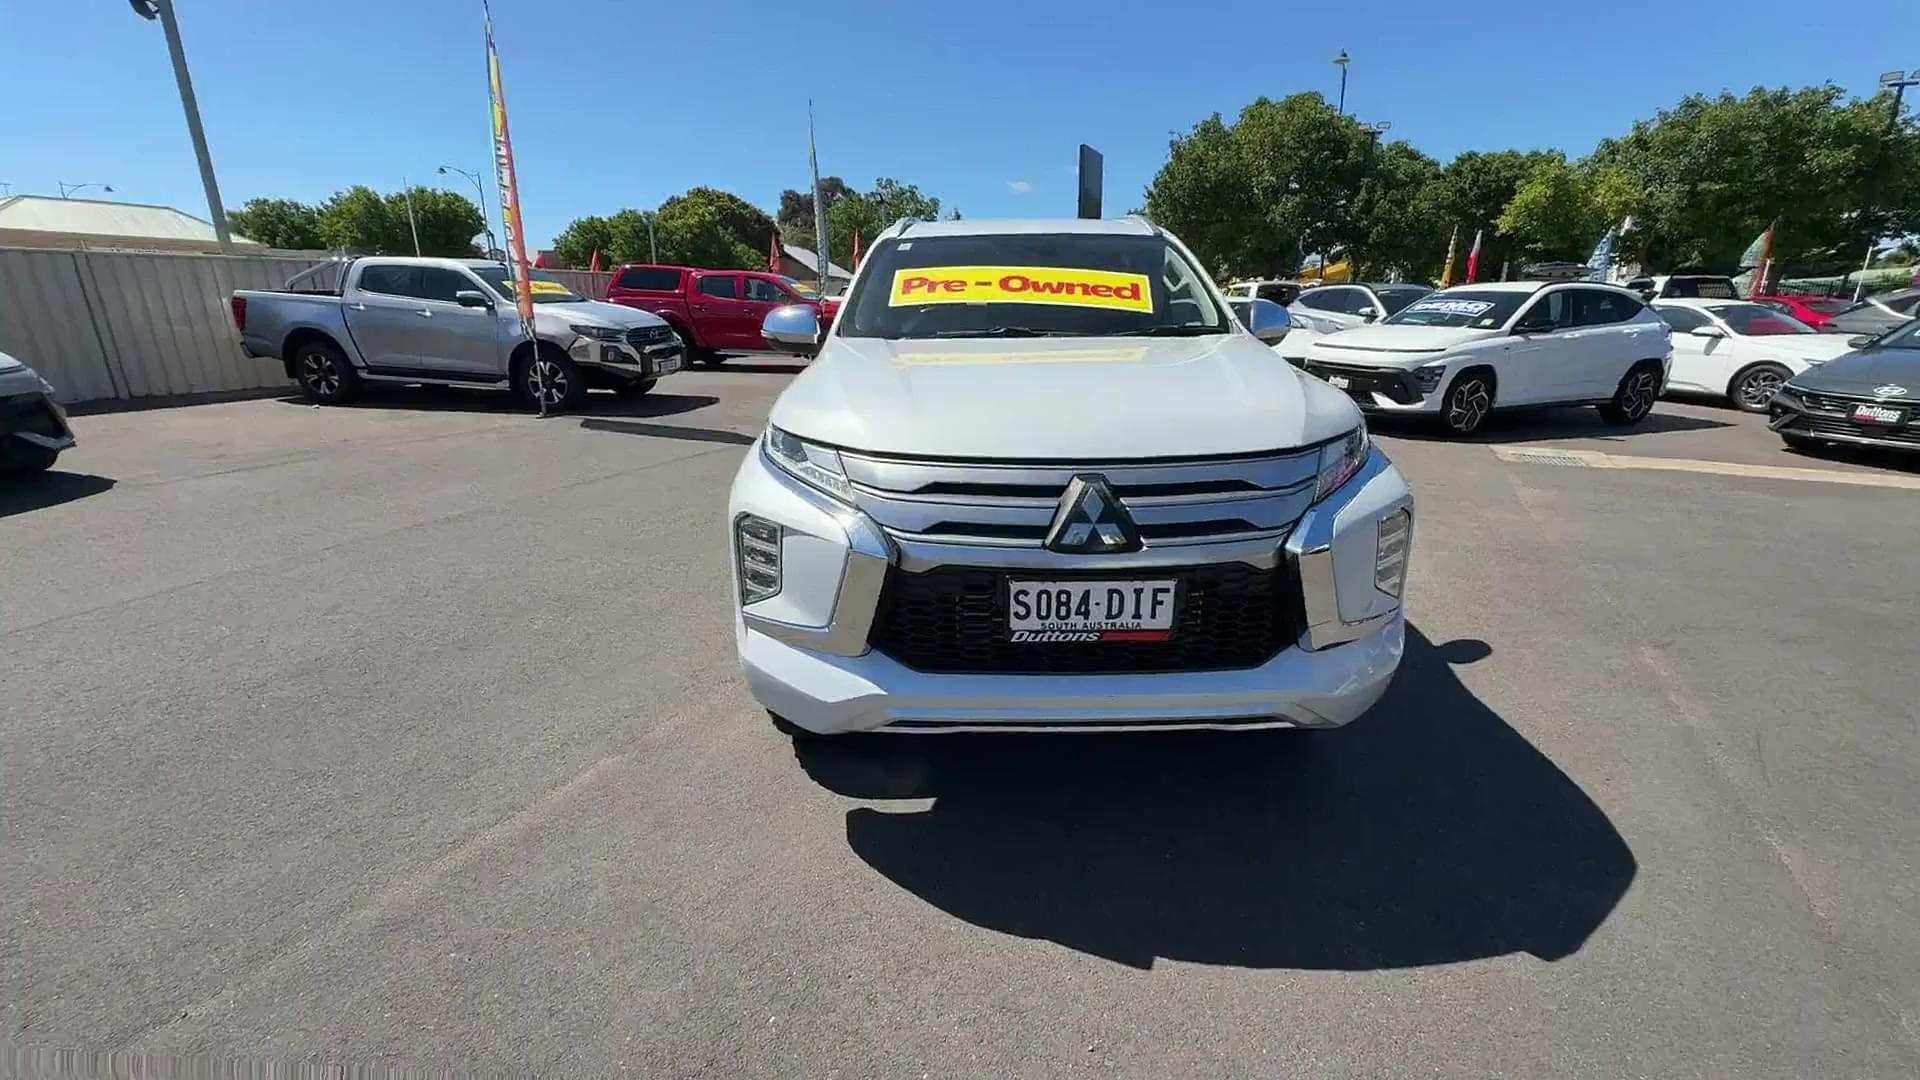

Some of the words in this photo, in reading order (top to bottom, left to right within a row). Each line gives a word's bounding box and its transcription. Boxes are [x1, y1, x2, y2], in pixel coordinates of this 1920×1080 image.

[1041, 622, 1077, 630] SOUTH
[1082, 621, 1142, 630] AUSTRALIA
[1010, 631, 1100, 642] Duttons
